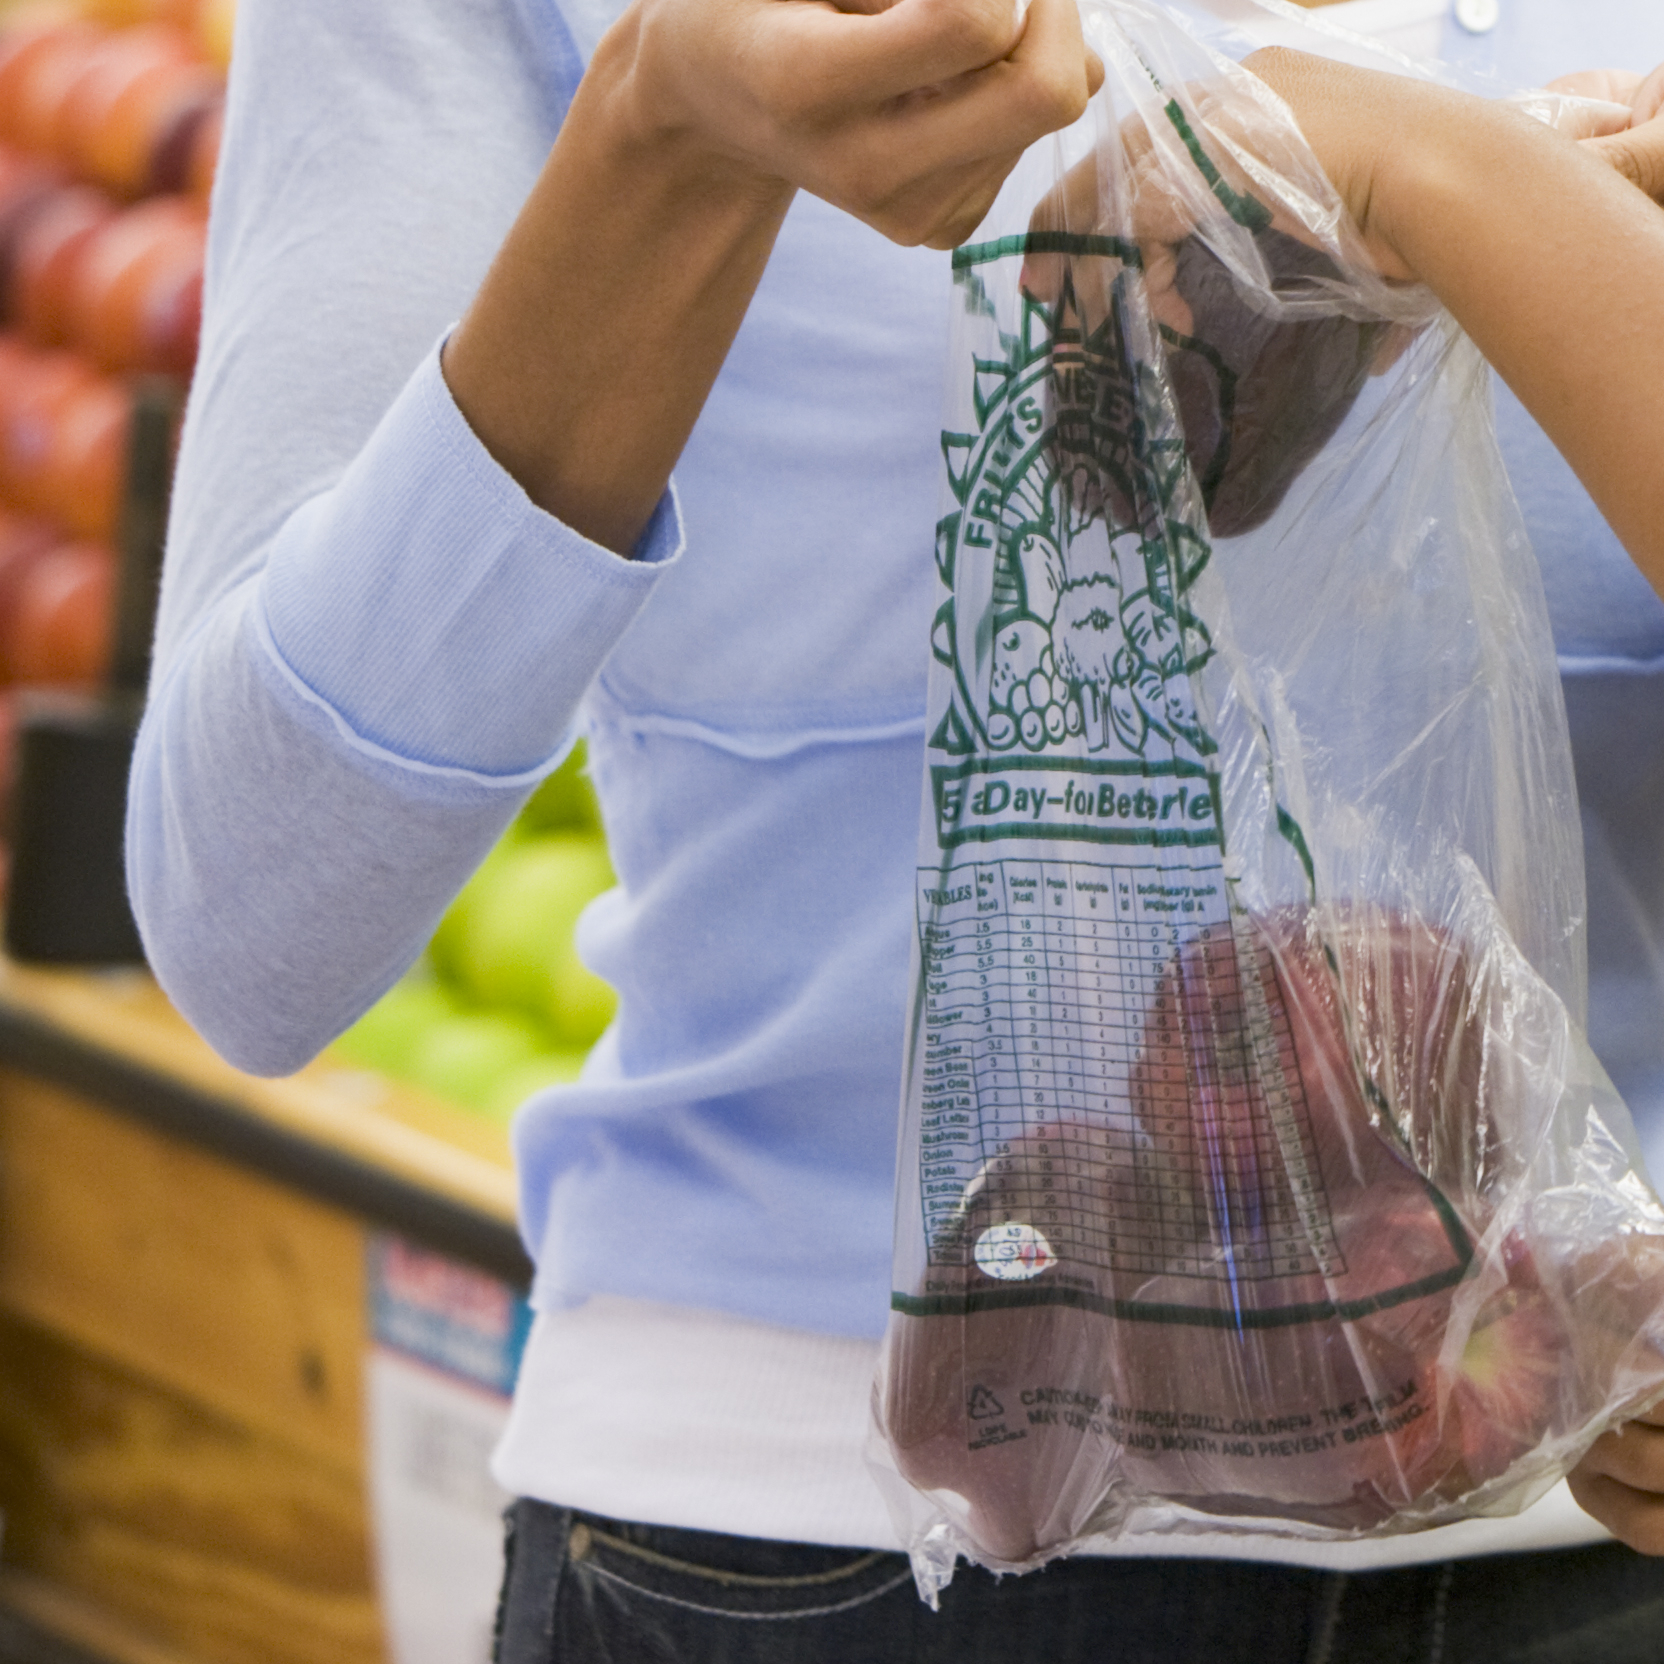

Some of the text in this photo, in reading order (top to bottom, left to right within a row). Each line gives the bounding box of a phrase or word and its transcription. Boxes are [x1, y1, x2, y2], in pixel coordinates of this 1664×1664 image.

[942, 788, 961, 822] 5
[1151, 926, 1159, 938] 0
[1153, 945, 1159, 956] 0
[923, 1149, 954, 1161] Onion
[1128, 1433, 1156, 1450] AND
[1258, 1432, 1337, 1458] PREVENT
